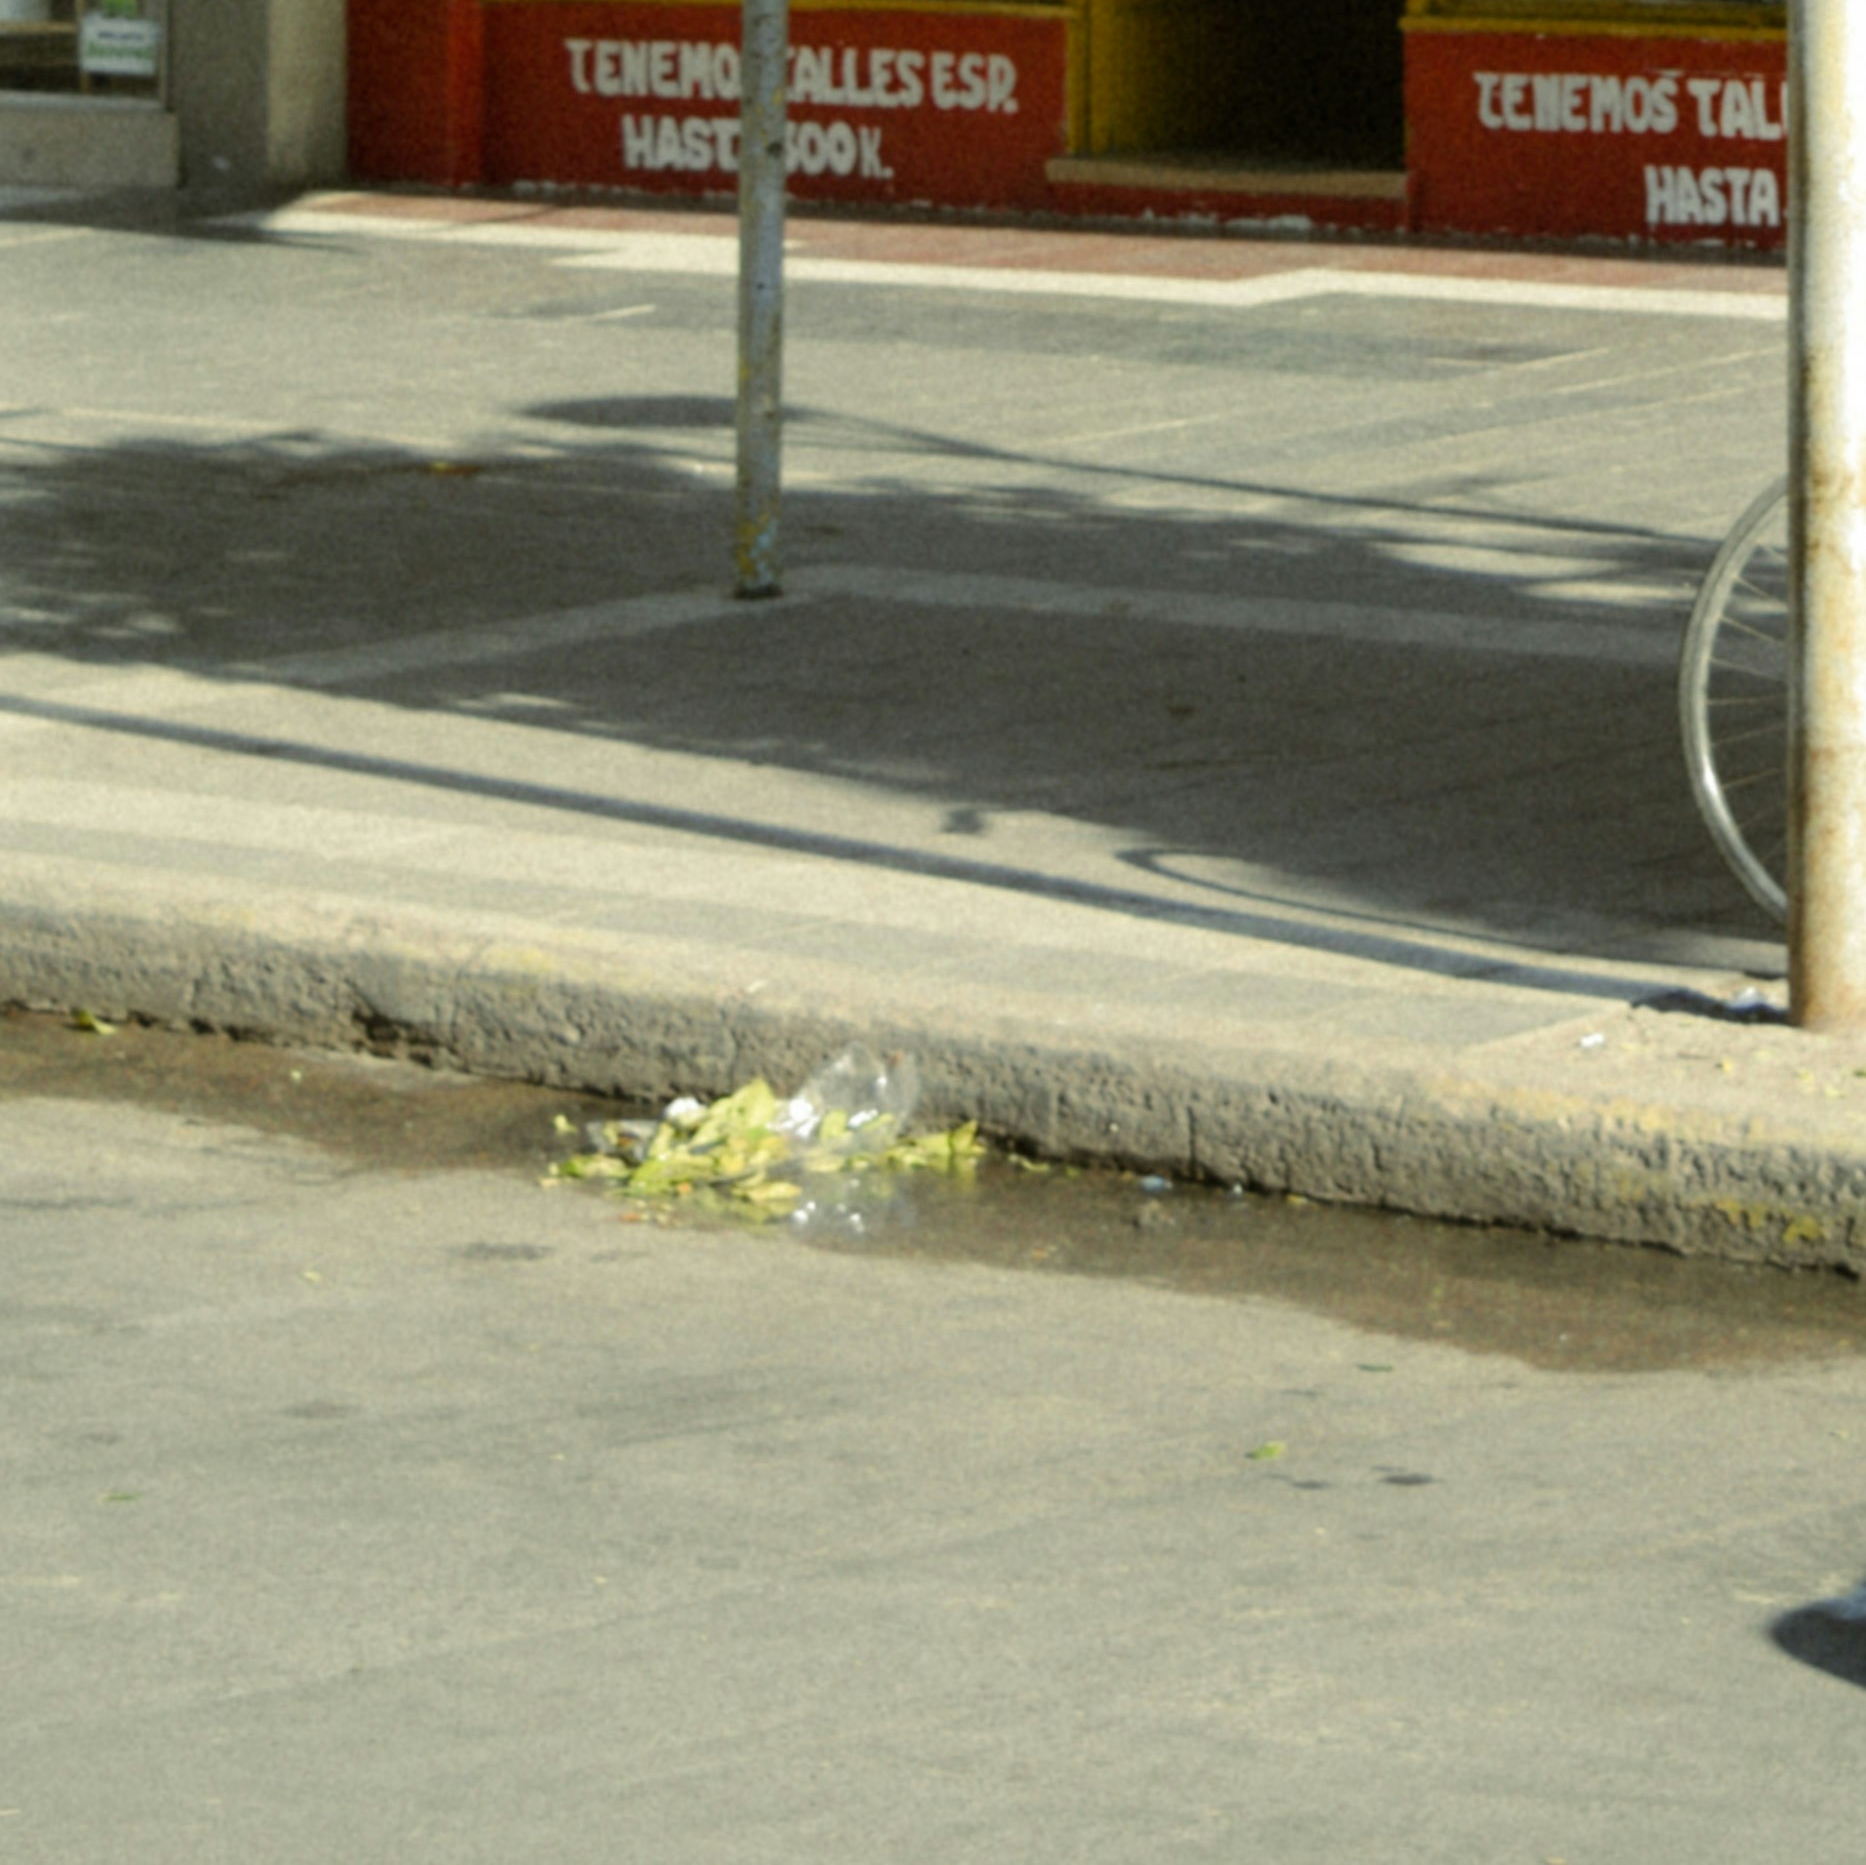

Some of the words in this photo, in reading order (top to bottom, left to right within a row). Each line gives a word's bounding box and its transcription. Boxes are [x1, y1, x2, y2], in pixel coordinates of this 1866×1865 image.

[564, 38, 742, 101] TENEMO
[787, 44, 925, 109] ALLES
[1473, 70, 1680, 135] TENEMOS
[621, 113, 742, 170] HAST
[1643, 164, 1781, 228] HASTA
